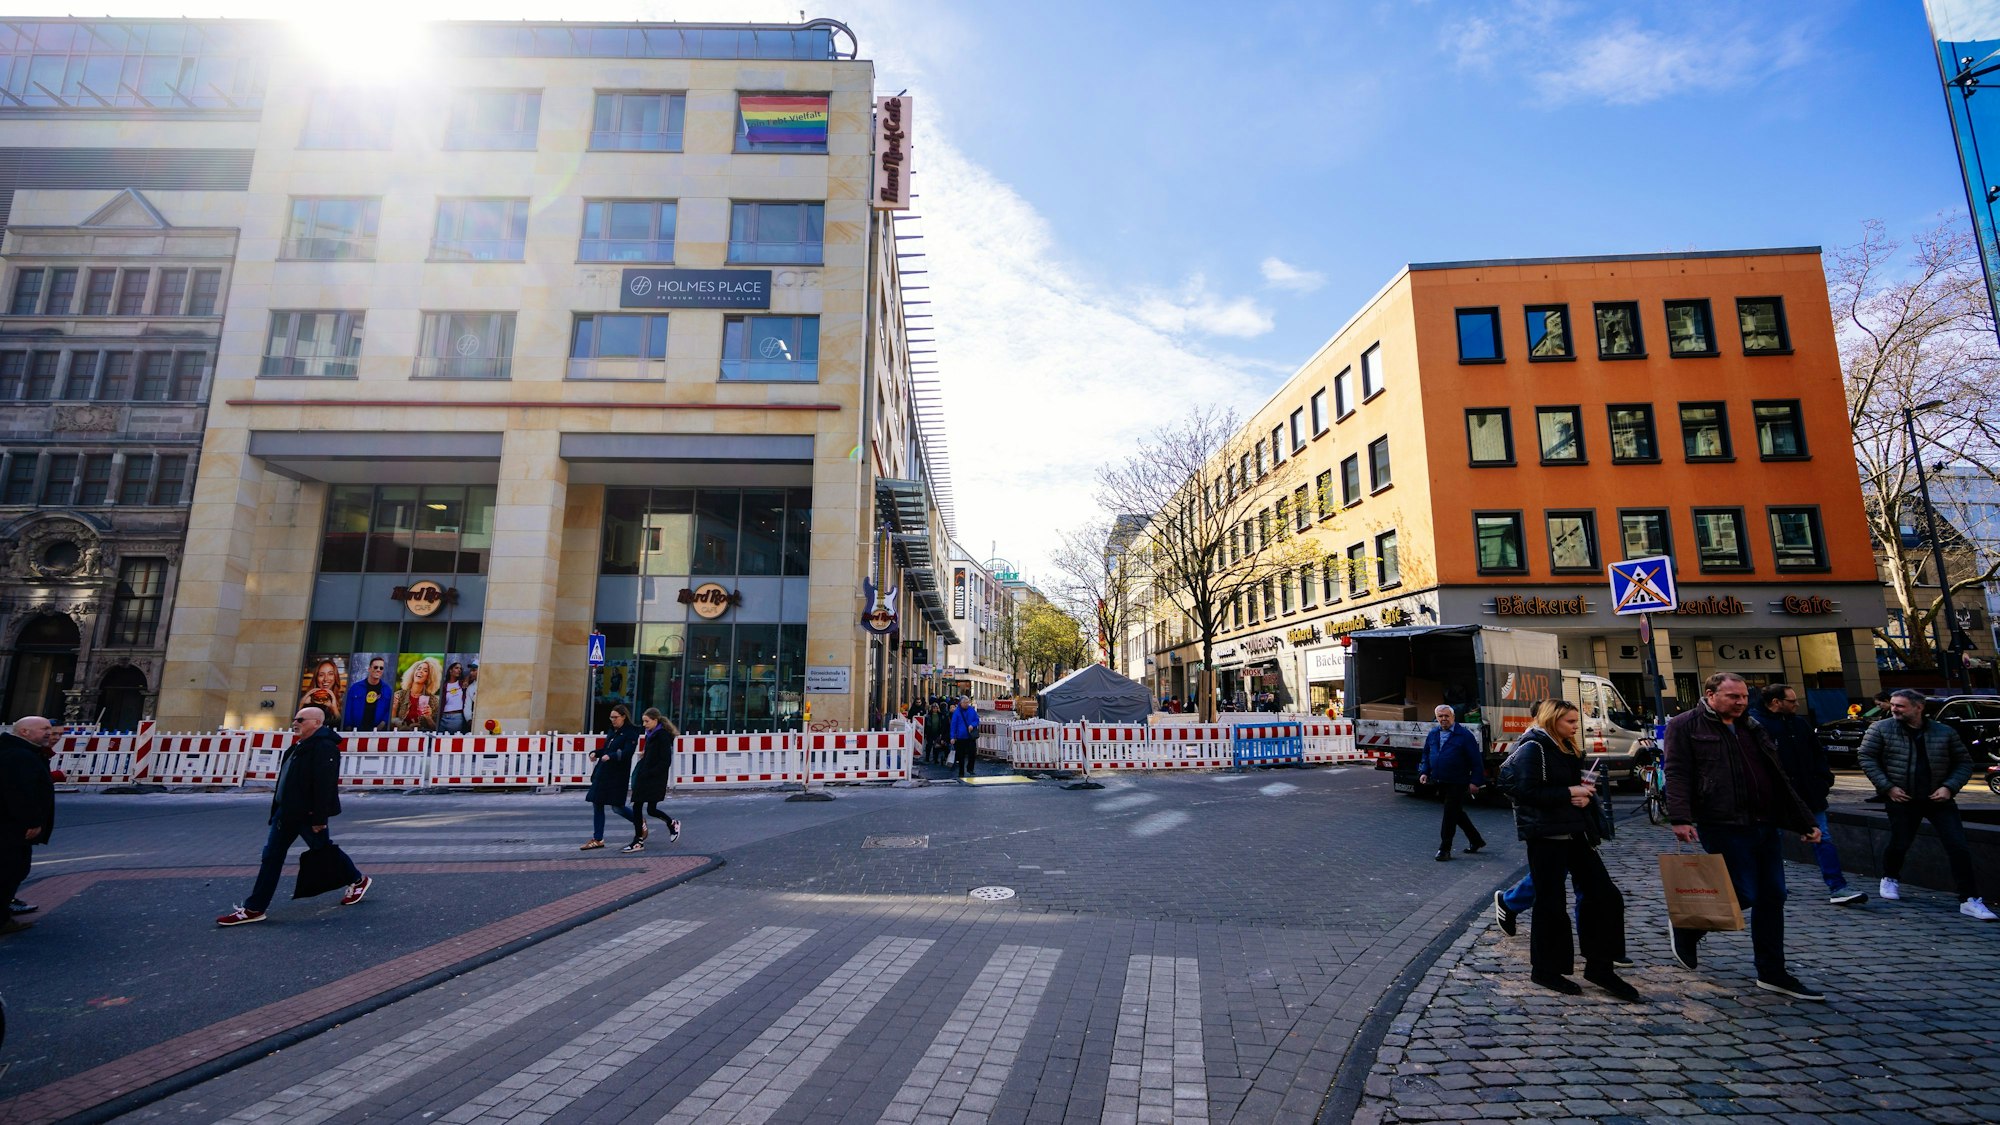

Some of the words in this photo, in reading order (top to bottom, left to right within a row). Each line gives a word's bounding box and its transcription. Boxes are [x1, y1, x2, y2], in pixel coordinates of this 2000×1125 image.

[789, 109, 822, 123] Vielfalt
[882, 129, 904, 166] Rock
[880, 164, 899, 203] Hard
[657, 280, 715, 293] HOLMES
[718, 281, 762, 293] PLACE
[677, 588, 711, 604] Hard
[955, 585, 964, 617] SATURN
[1496, 593, 1588, 615] Bäckerei
[1784, 594, 1834, 614] Cafe
[1718, 644, 1777, 660] Cafe
[1242, 668, 1262, 676] KIOSK
[1519, 673, 1551, 700] AWB
